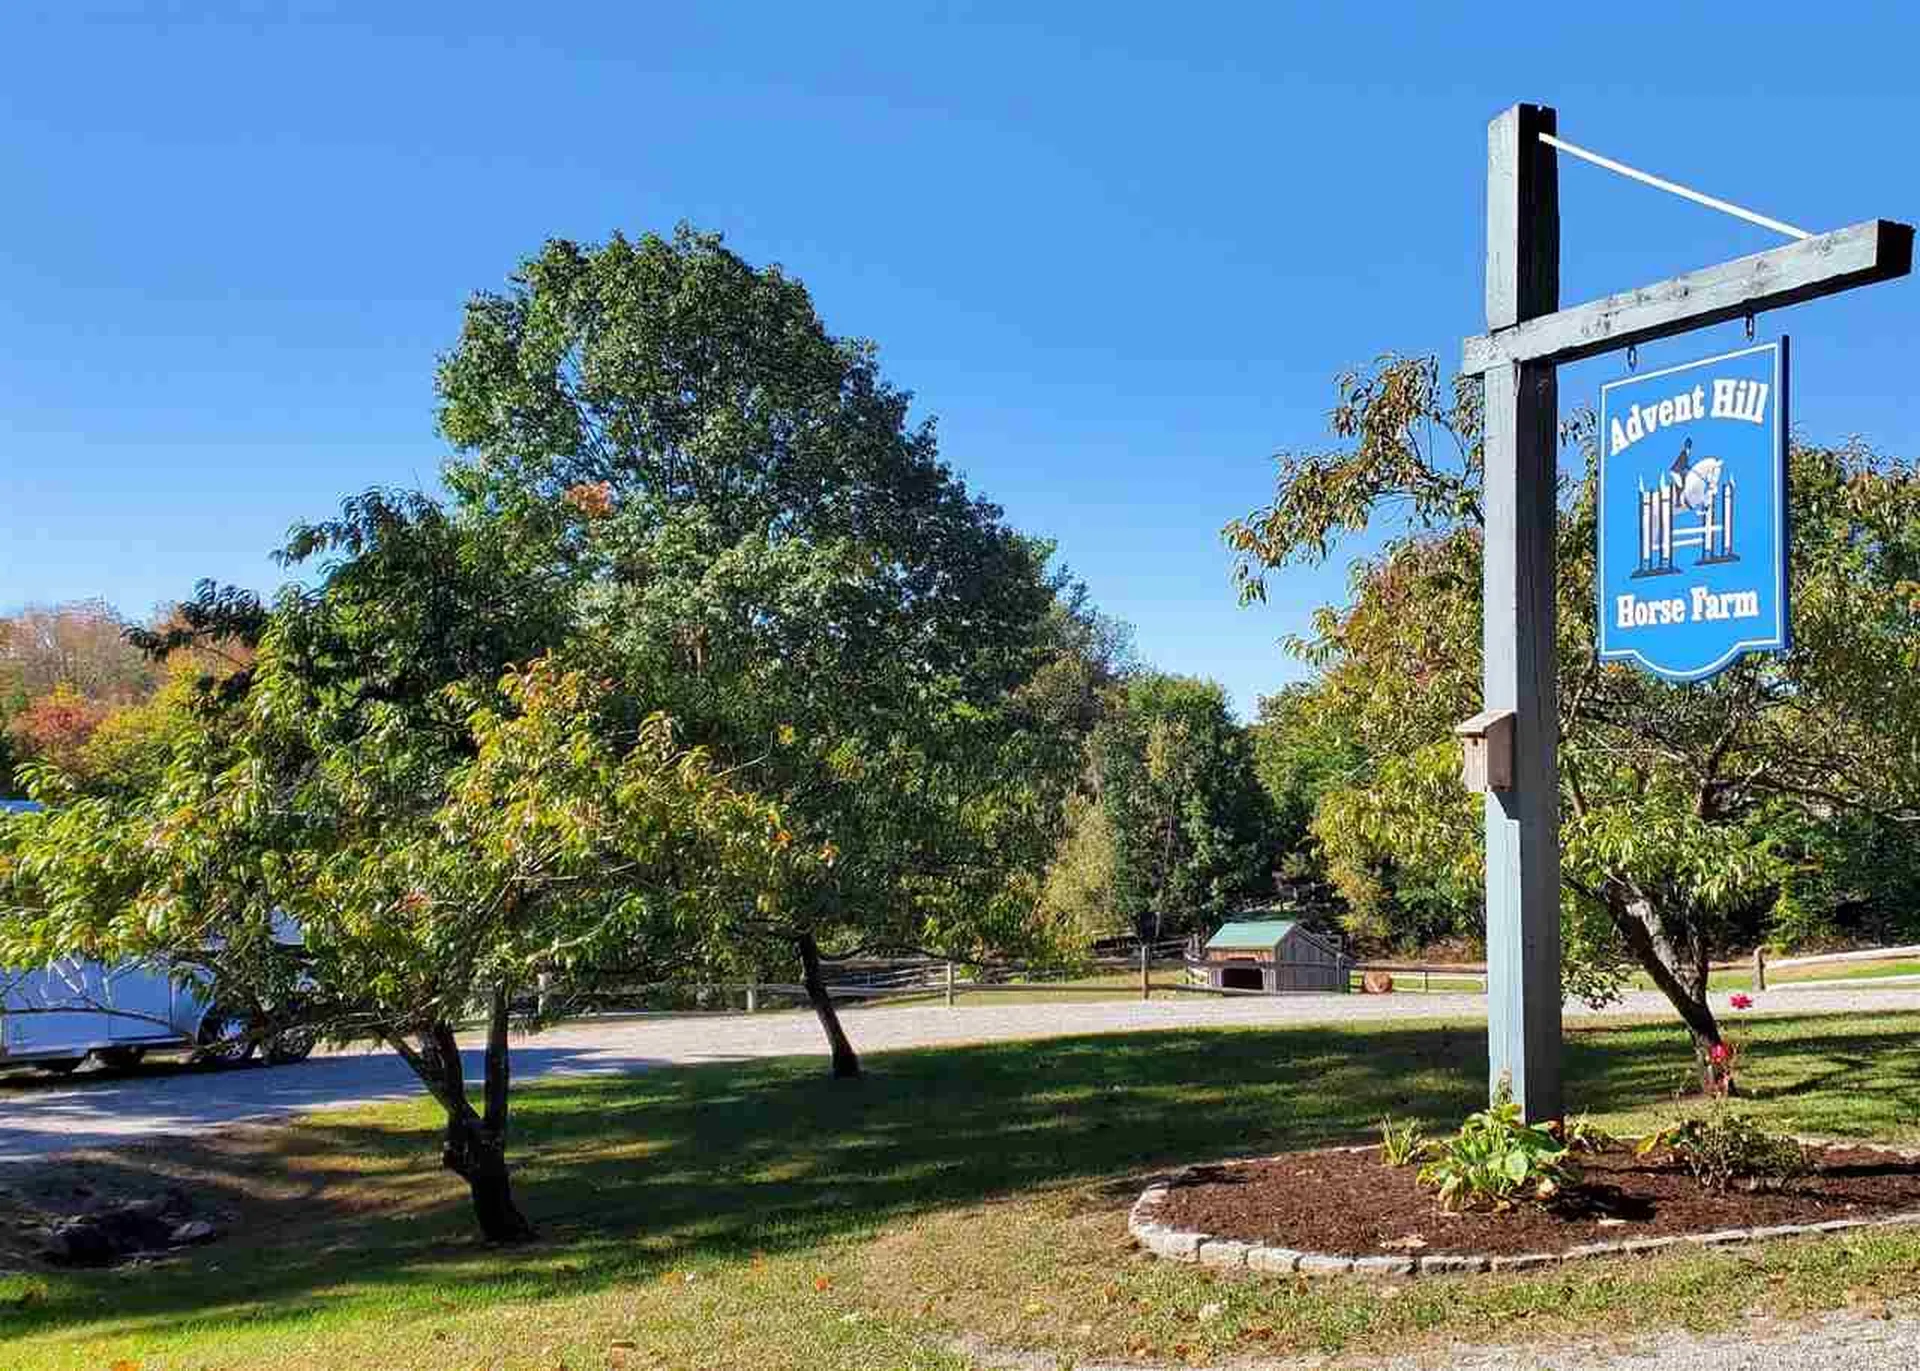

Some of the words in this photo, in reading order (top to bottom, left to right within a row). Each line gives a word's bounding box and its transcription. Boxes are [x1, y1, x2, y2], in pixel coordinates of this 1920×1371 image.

[1609, 383, 1704, 456] Advent
[1710, 378, 1768, 424] Hill
[1616, 594, 1686, 628] Horse
[1690, 586, 1759, 622] Farm
